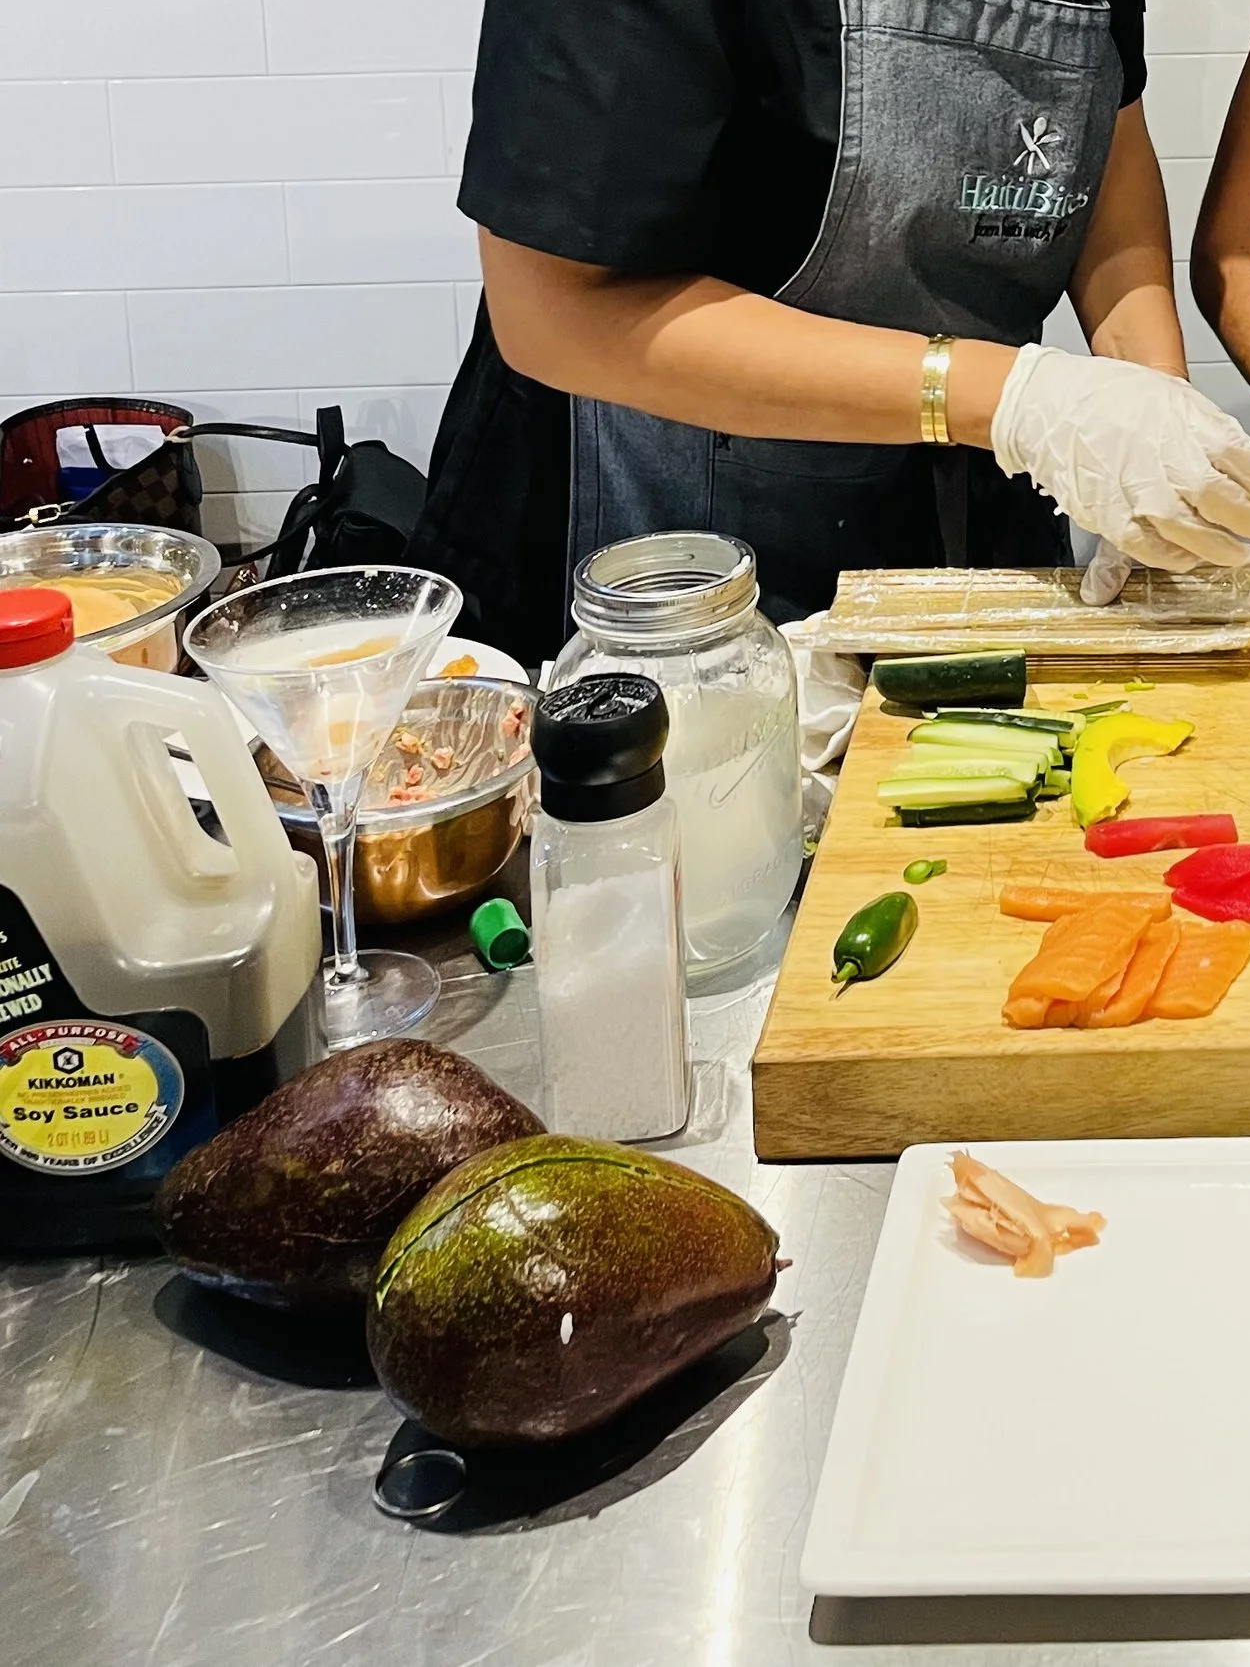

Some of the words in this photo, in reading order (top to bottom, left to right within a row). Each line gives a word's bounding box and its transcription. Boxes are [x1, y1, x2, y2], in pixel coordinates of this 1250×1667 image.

[27, 1072, 116, 1090] KIKKOMAN
[13, 1106, 55, 1124] Soy
[63, 1101, 140, 1120] Sauce
